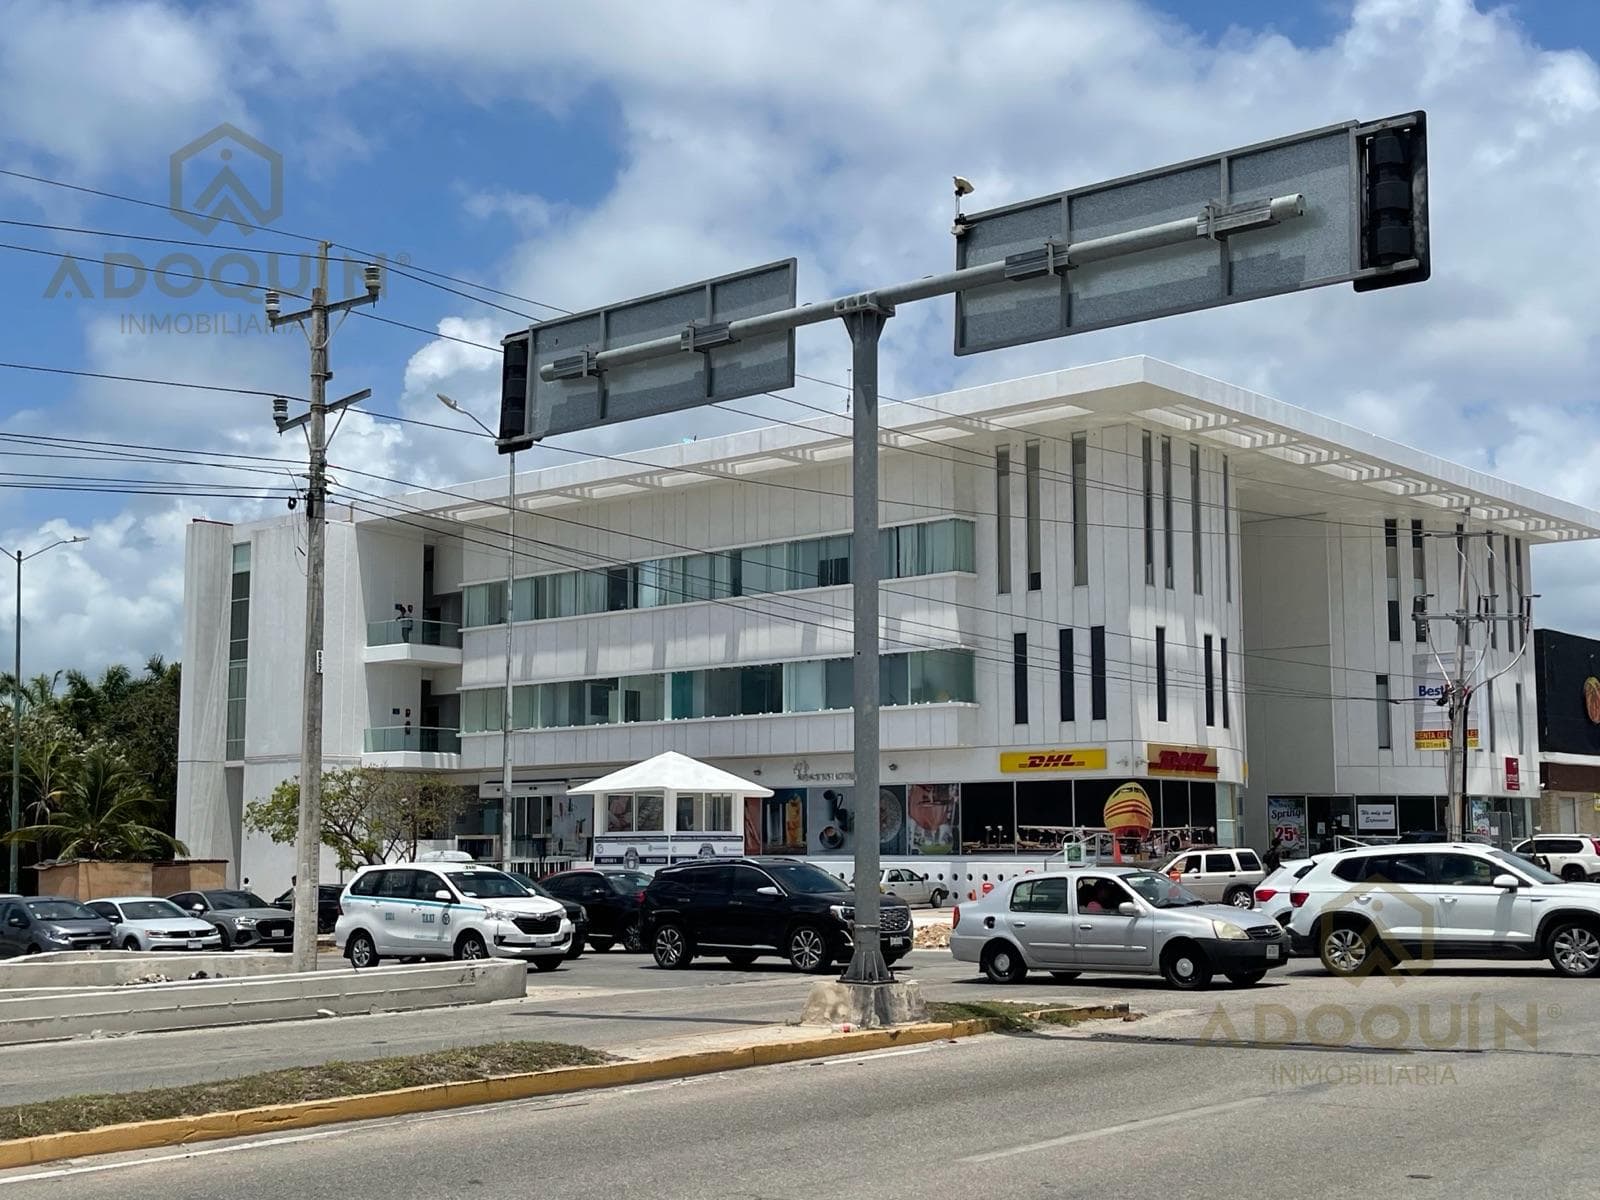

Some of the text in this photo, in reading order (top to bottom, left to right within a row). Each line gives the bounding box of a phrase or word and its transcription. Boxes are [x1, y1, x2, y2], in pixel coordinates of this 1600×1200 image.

[1418, 683, 1472, 698] Besty
[1027, 754, 1076, 768] DHL
[1271, 808, 1301, 821] Spring
[422, 913, 435, 924] TAXI
